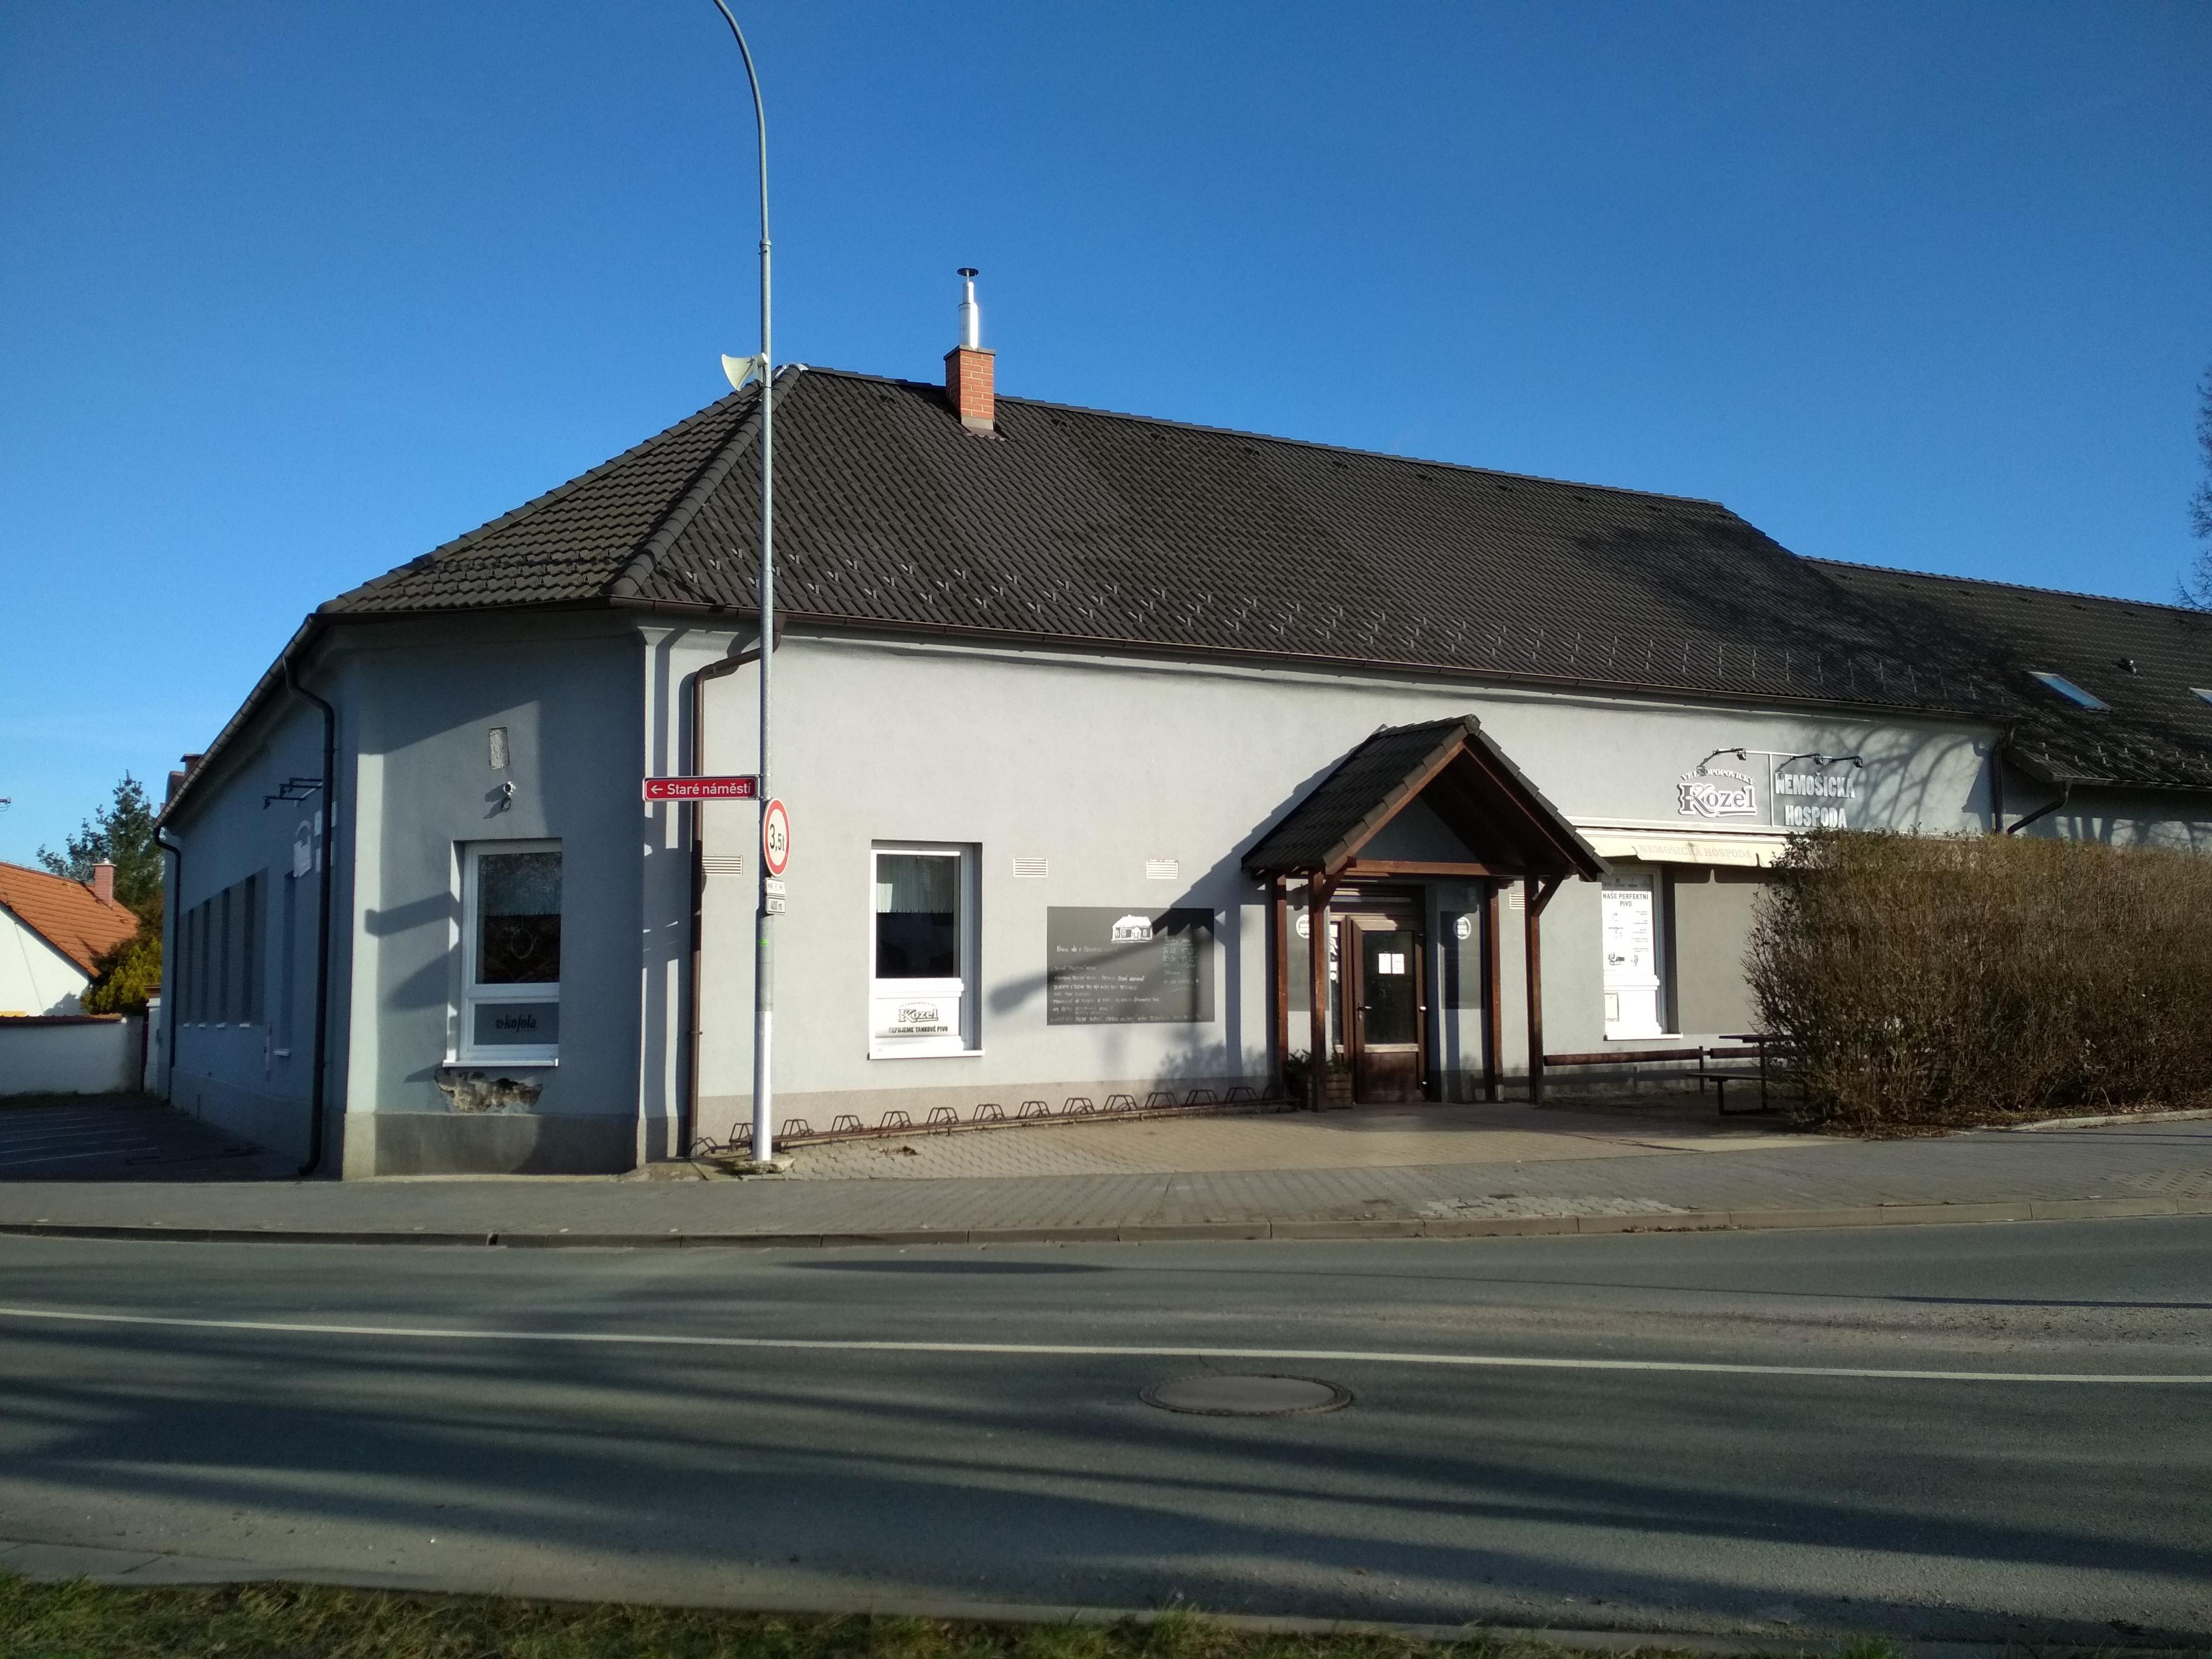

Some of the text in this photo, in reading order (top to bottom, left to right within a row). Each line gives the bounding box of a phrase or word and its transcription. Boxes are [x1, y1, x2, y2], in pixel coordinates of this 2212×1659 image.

[667, 782, 752, 795] Staré náměstí
[1775, 771, 1855, 798] NEMOŠICKÁ
[1679, 782, 1757, 817] Kozel
[1785, 805, 1847, 828] HOSPODA
[1704, 848, 1753, 859] HOSPODA
[1603, 891, 1648, 900] NAŠE PERFEKTNÍ
[504, 1013, 536, 1033] kofola
[898, 1009, 938, 1022] Kozel
